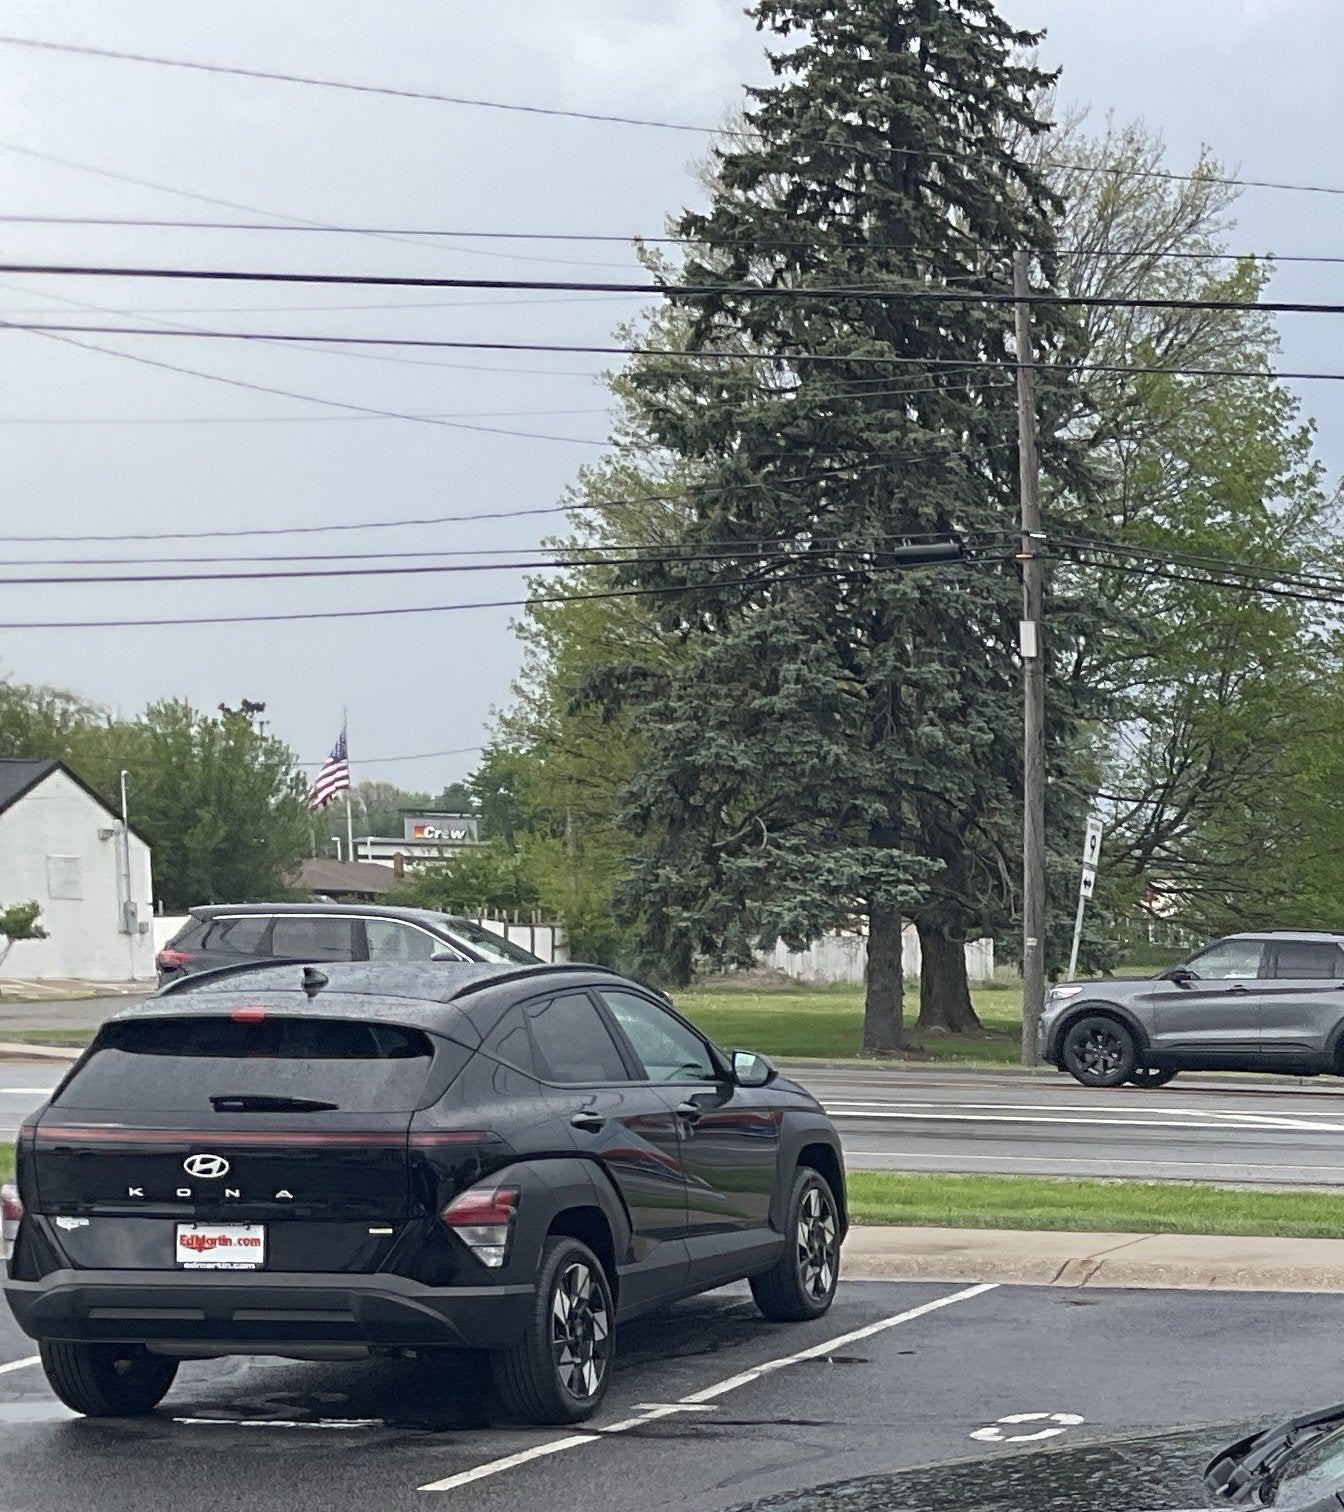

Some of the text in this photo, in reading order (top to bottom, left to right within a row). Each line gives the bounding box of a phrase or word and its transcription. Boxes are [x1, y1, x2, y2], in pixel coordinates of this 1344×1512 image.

[424, 826, 466, 839] Crew
[1090, 834, 1097, 859] 9
[128, 1187, 294, 1199] KONA
[179, 1234, 261, 1250] EdMartin.com
